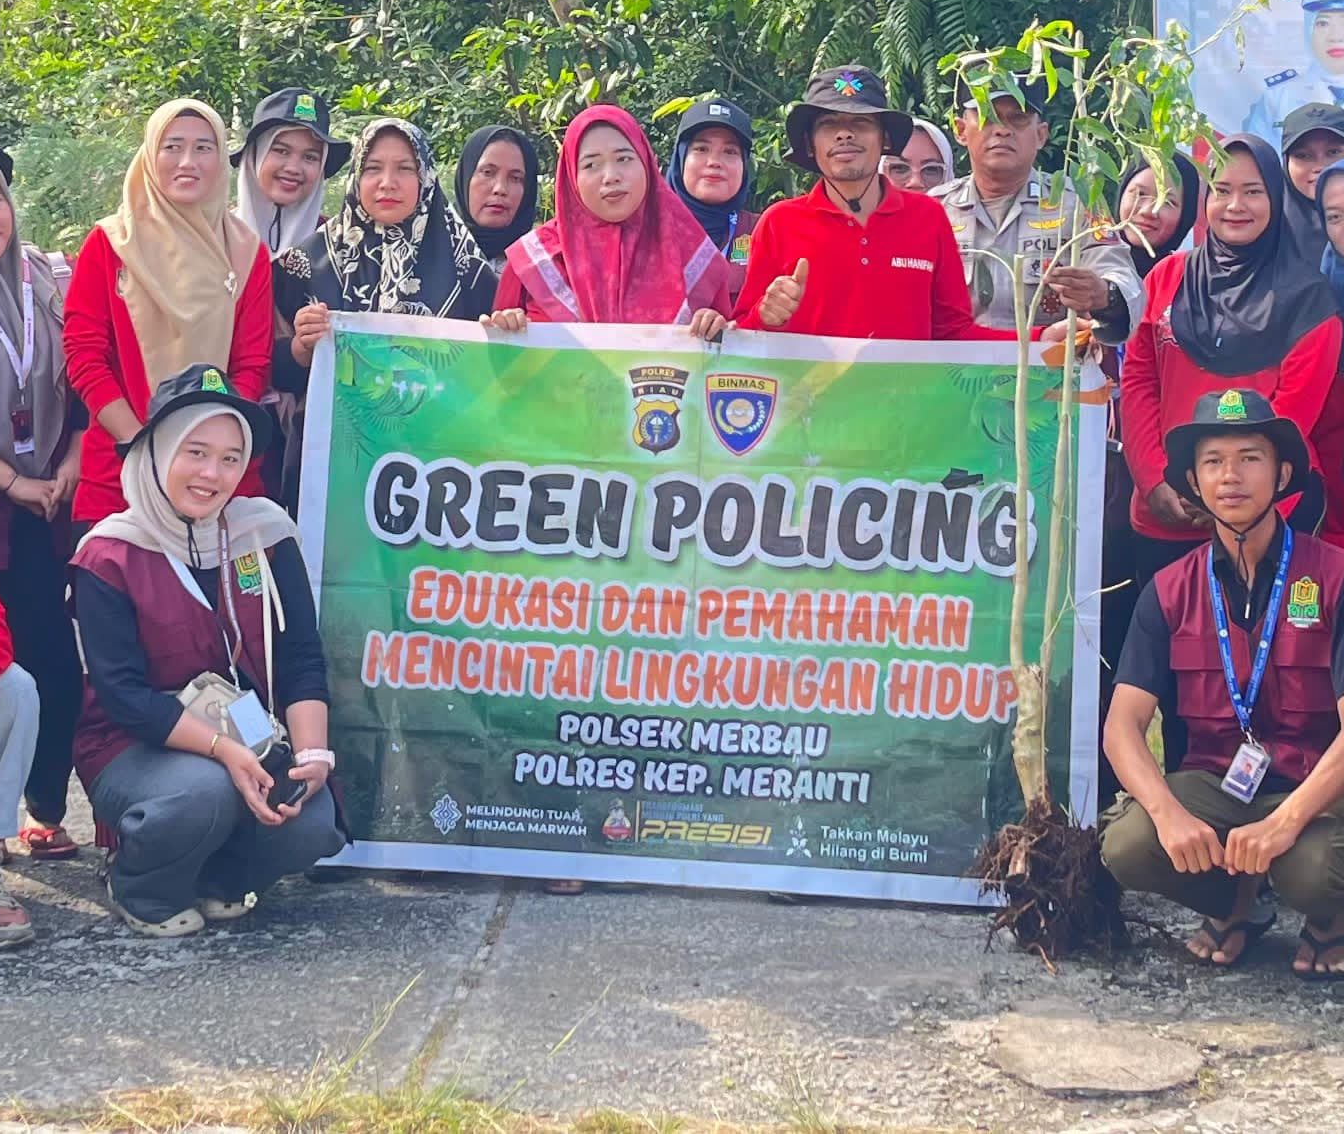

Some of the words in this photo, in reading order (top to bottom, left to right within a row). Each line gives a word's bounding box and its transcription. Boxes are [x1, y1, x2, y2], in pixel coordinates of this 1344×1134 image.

[641, 368, 675, 377] POLRES
[718, 377, 766, 391] BINMAS
[638, 386, 678, 396] RIAU
[373, 461, 628, 550] GREEN
[651, 479, 1022, 567] POLICING
[410, 570, 591, 630] EDUKASI
[600, 585, 687, 635] DAN
[697, 589, 969, 647] PEMAHAMAN
[366, 634, 594, 700] MENCINTAI
[604, 649, 875, 713] LINGKUNGAN
[889, 664, 1019, 720] HIDUP
[559, 714, 684, 749] POLSEK
[690, 721, 829, 757] MERBAU
[514, 753, 636, 790] POLRES
[643, 760, 713, 794] KEP.
[722, 767, 870, 803] MERANTI
[466, 804, 544, 819] MELINDUNGI
[465, 819, 526, 832] MENJAGA
[527, 823, 587, 836] MARWAH
[640, 819, 772, 845] PRESISI
[820, 825, 872, 842] Takkan
[877, 829, 929, 848] Melayu
[820, 843, 867, 862] Hilang
[871, 846, 885, 860] di
[889, 847, 928, 864] Bumi
